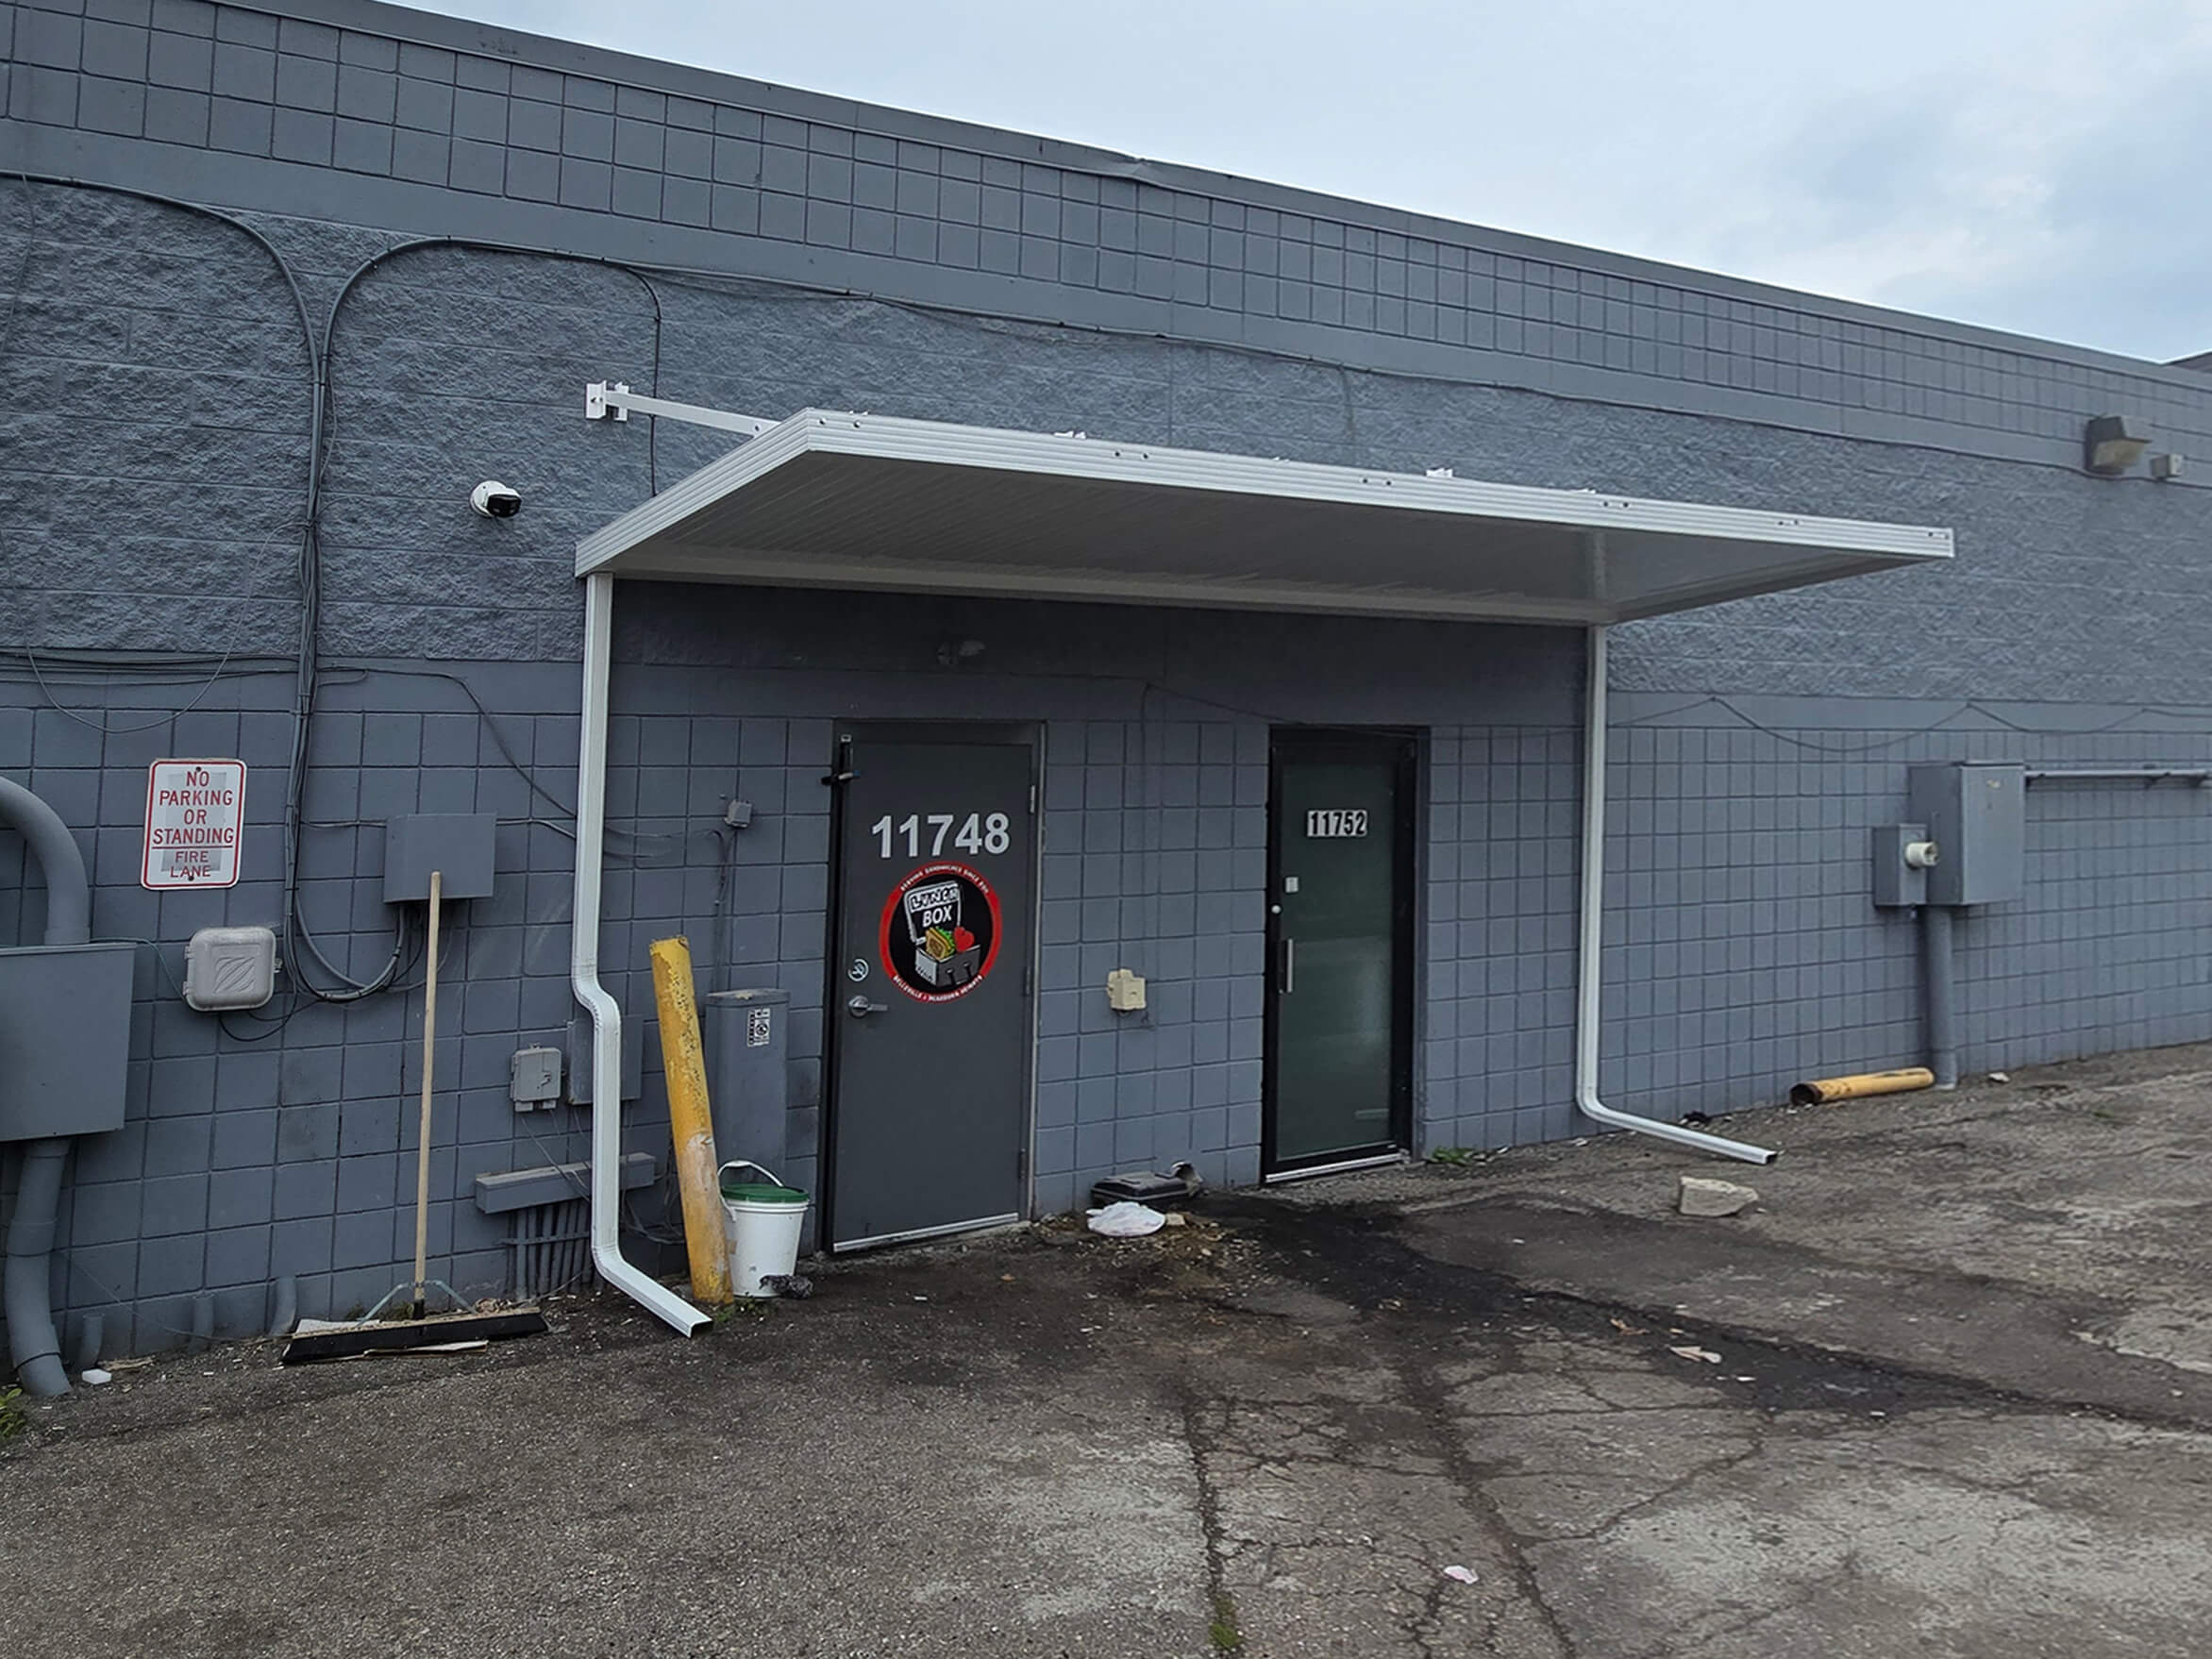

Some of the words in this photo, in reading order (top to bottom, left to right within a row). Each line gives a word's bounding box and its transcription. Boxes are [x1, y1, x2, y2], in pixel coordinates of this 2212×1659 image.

[186, 770, 209, 787] NO
[159, 789, 234, 806] PARKING
[183, 809, 208, 825] OR
[1310, 811, 1366, 836] 11752
[152, 827, 235, 845] STANDING
[872, 813, 1011, 859] 11748
[175, 850, 209, 863] FIRE
[170, 864, 212, 879] LANE
[910, 886, 960, 910] LUNCH
[922, 905, 953, 928] BOX
